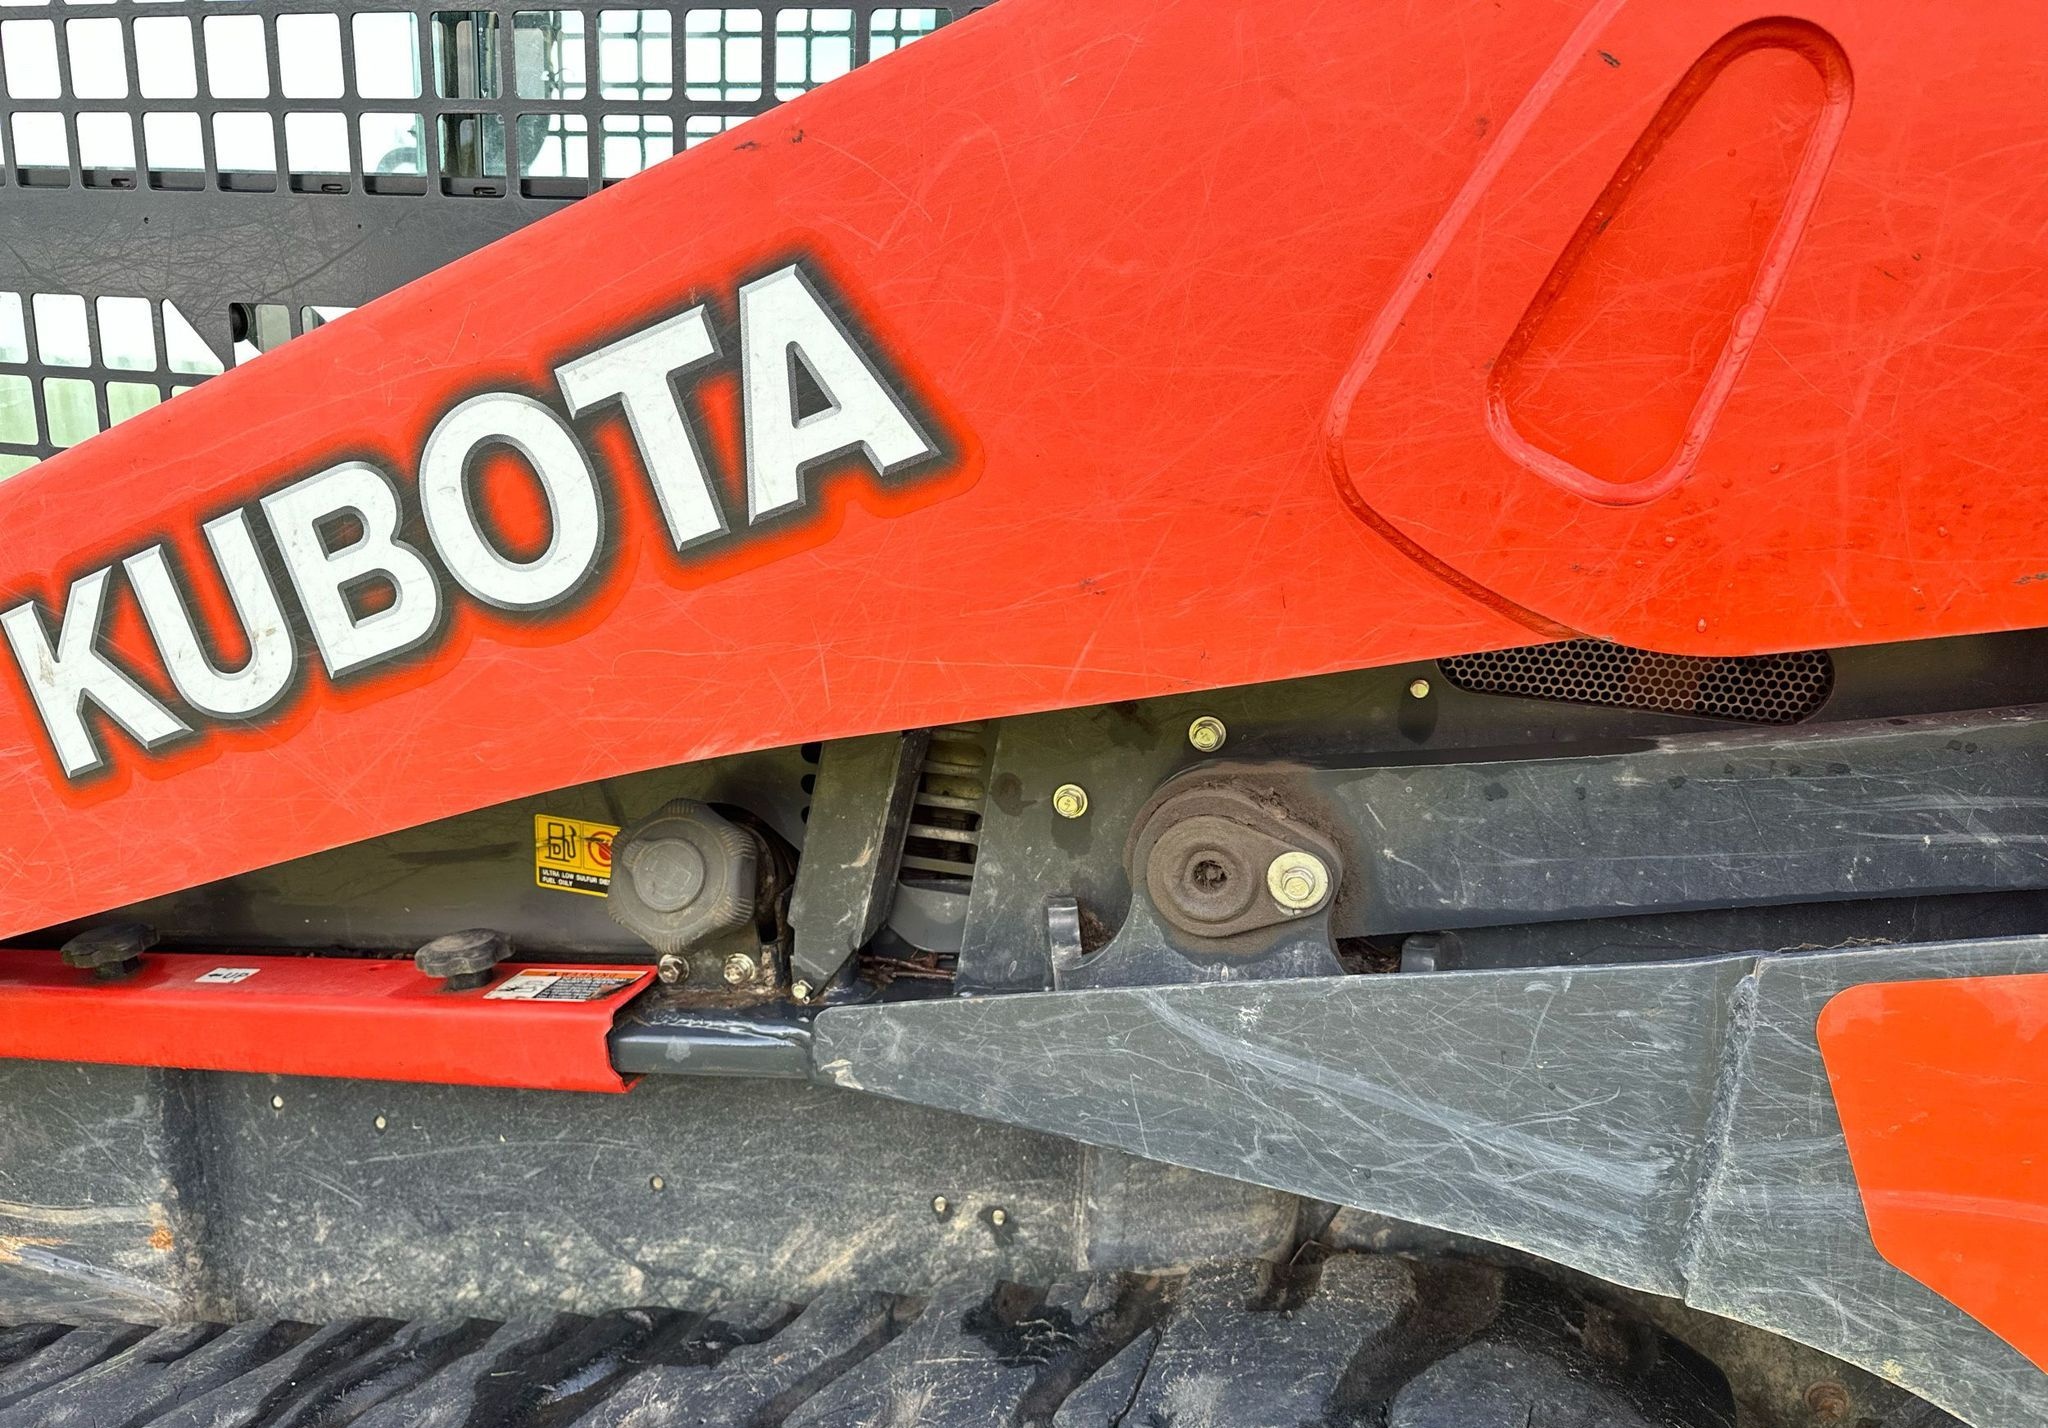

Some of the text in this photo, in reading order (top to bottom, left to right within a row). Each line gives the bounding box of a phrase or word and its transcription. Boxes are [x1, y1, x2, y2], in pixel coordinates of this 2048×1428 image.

[0, 263, 940, 778] KUBOTA
[542, 869, 560, 877] ULTRA
[576, 874, 597, 883] SULFUR
[542, 876, 573, 887] FUEL ONLY
[223, 971, 250, 979] UP
